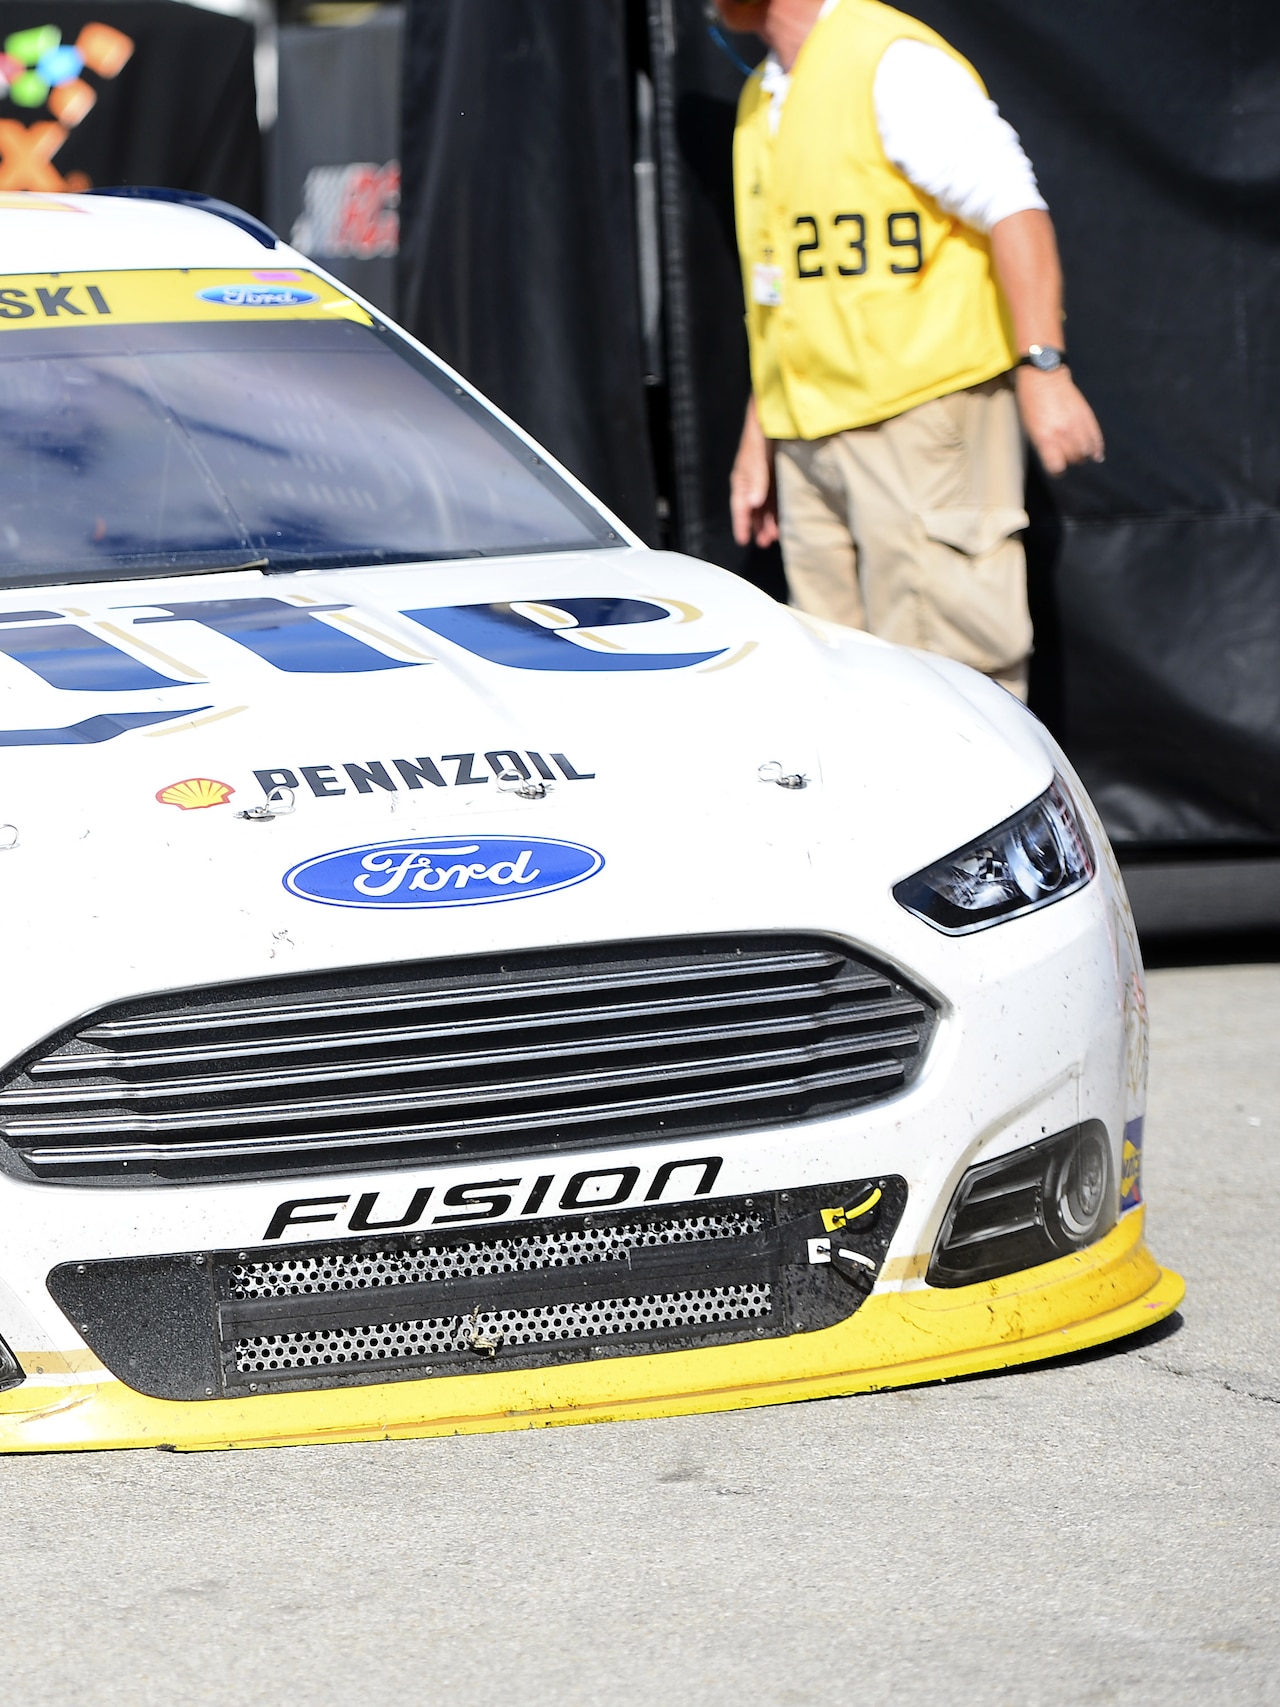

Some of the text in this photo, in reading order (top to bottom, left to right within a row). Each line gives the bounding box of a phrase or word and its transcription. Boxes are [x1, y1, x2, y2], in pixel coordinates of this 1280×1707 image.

[794, 212, 923, 279] 239
[221, 287, 298, 305] Ford
[253, 750, 596, 801] PENNZOIL
[353, 844, 541, 898] Ford
[262, 1156, 724, 1240] FUSION
